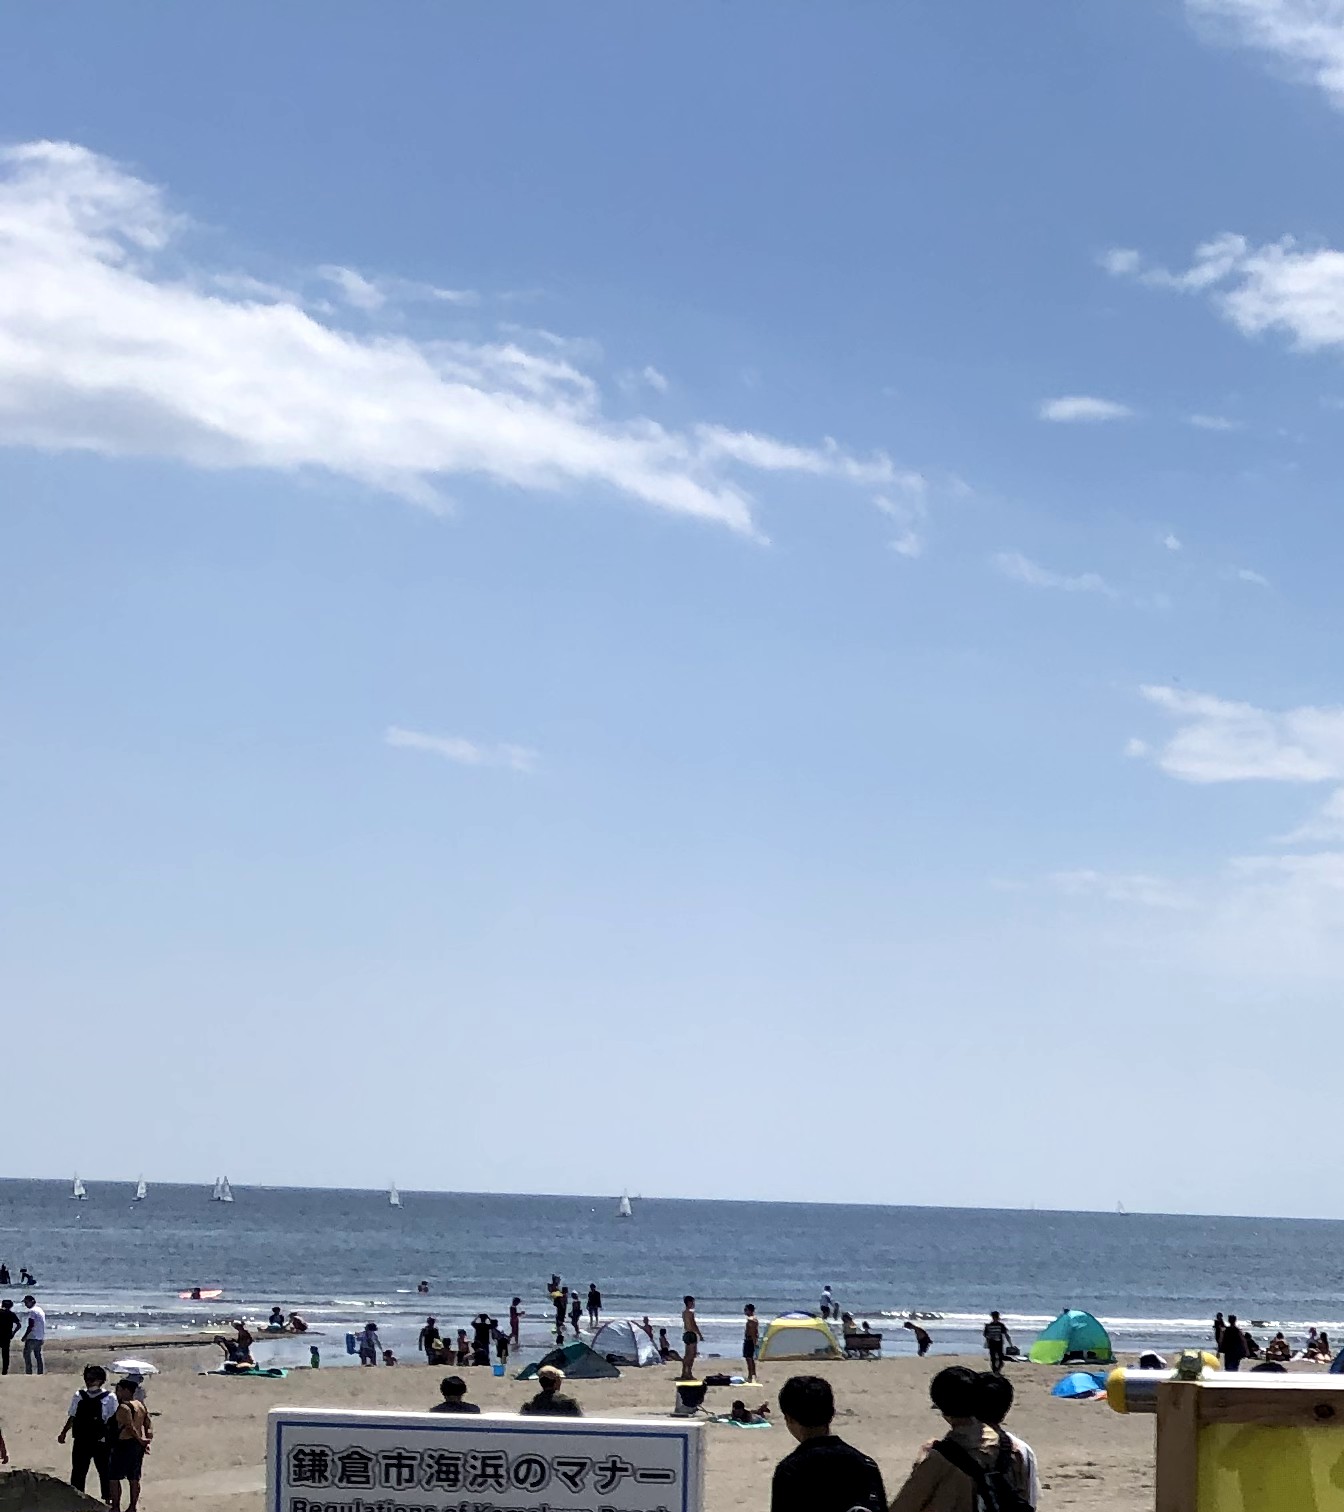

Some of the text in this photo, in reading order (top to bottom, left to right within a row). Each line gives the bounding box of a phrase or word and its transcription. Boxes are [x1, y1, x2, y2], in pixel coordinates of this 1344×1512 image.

[289, 1445, 676, 1494] 鎌倉市海浜のマナー
